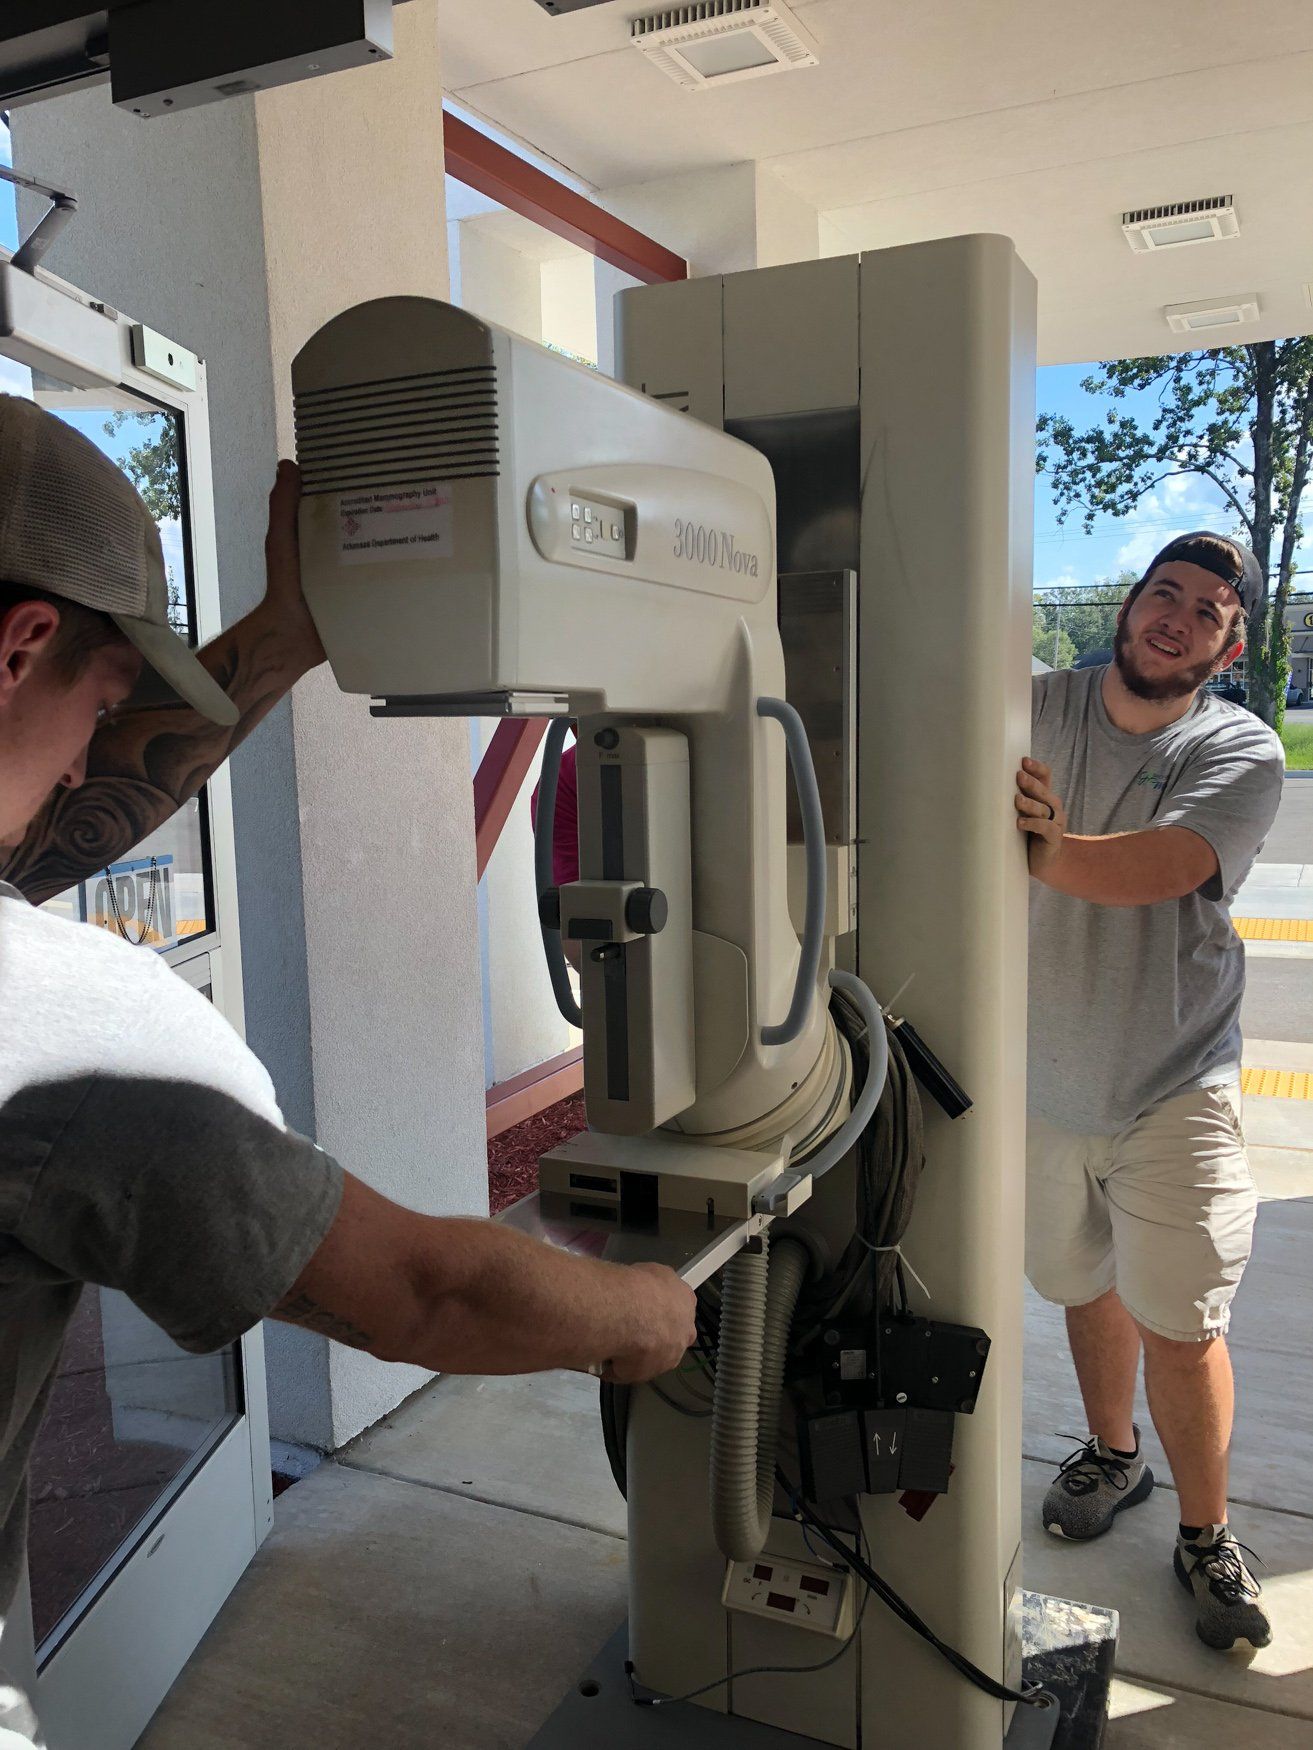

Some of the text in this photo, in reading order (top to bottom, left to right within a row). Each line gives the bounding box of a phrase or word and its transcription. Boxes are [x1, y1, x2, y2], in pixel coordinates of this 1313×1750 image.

[373, 489, 421, 501] Mammography
[422, 488, 437, 496] Unit
[372, 536, 409, 547] Department
[410, 534, 416, 543] of
[418, 532, 440, 542] Health
[95, 868, 172, 940] OPEN
